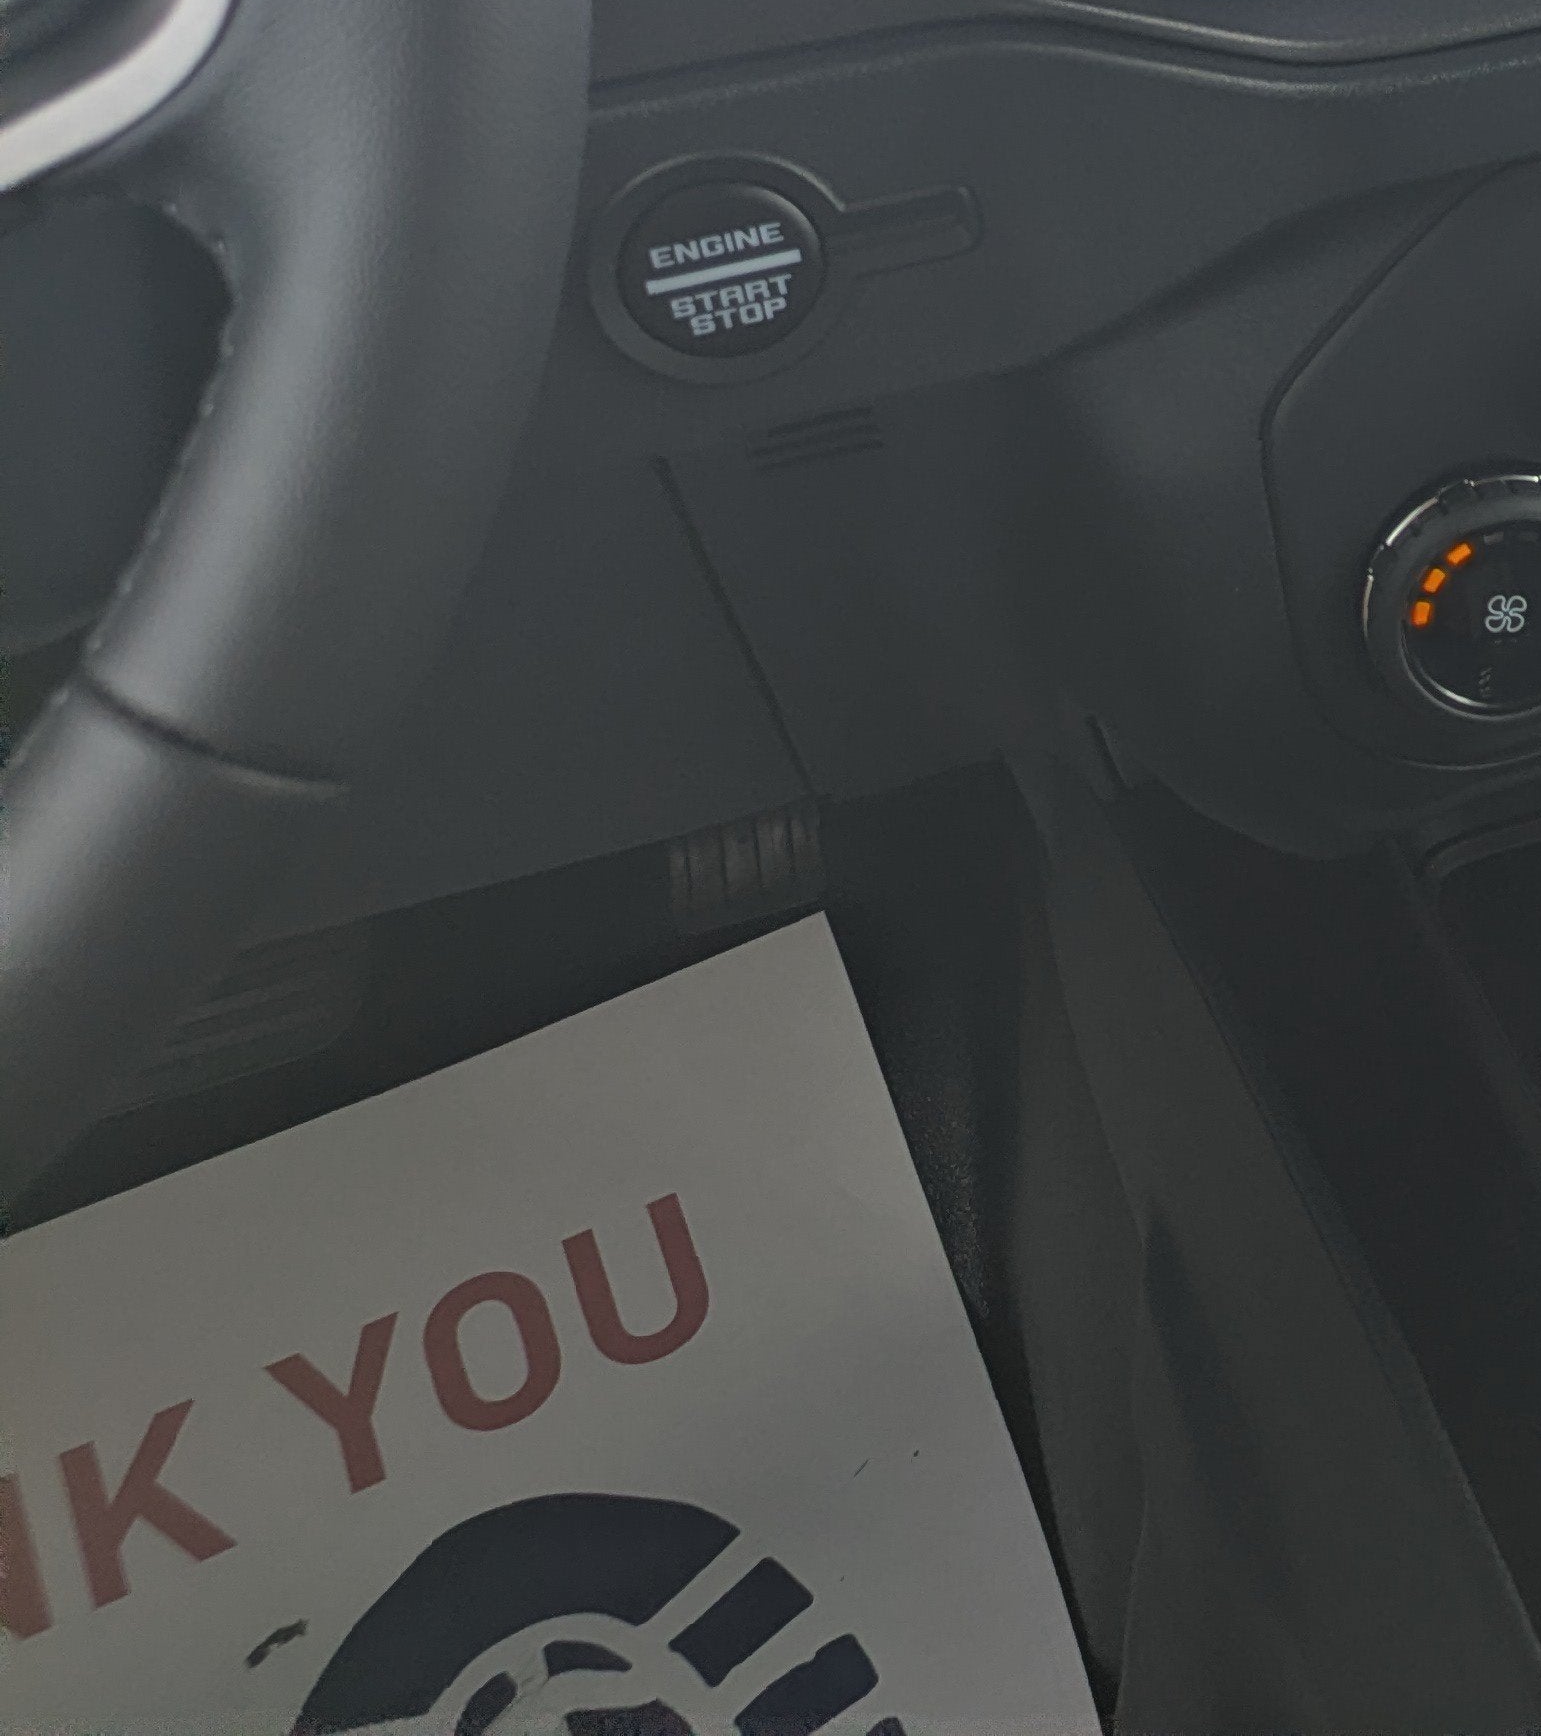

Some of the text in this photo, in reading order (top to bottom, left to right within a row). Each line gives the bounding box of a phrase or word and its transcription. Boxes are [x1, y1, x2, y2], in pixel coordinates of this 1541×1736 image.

[648, 222, 784, 269] ENGINE
[670, 273, 792, 320] START
[689, 297, 788, 337] STOP
[263, 1191, 711, 1496] YOU
